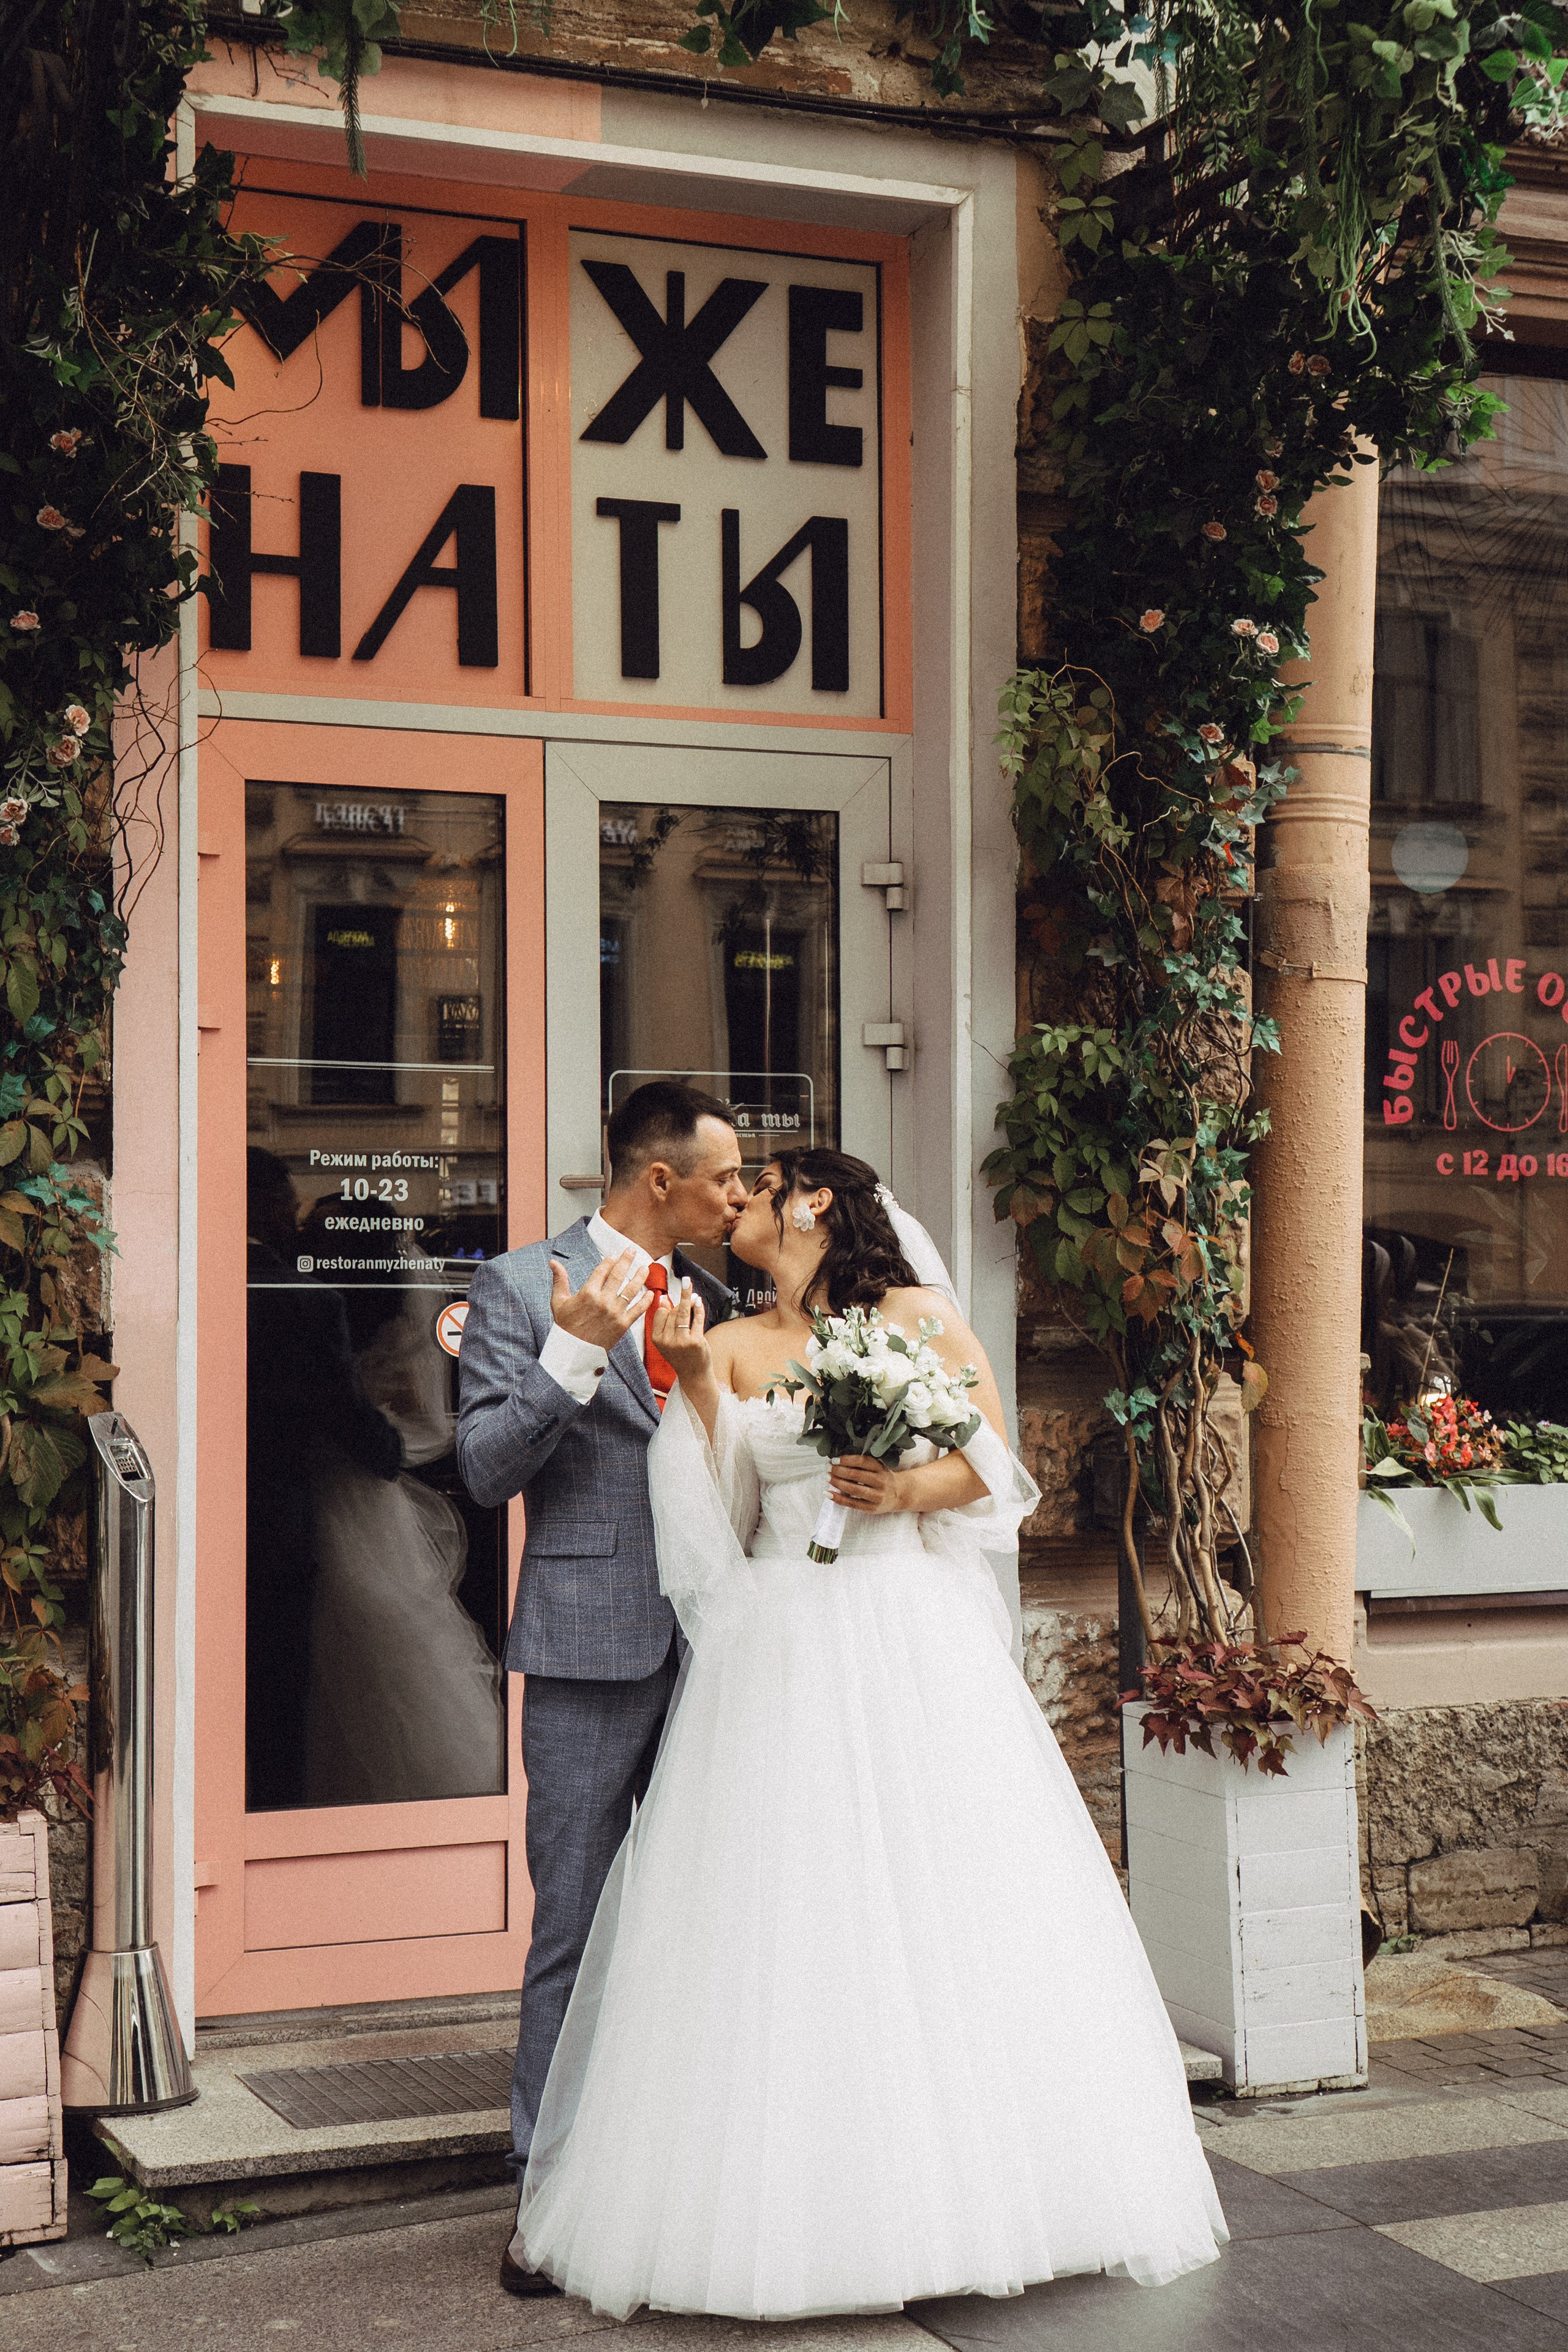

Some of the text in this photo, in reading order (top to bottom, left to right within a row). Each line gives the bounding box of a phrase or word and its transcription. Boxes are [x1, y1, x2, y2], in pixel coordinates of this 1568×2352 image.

[579, 259, 863, 466] ЖЕ
[209, 462, 849, 692] НА ТЫ
[1383, 958, 1526, 1125] БЫСТРЫЕ
[761, 1113, 801, 1128] ты
[310, 1150, 439, 1170] Режим работы:
[1463, 1150, 1489, 1175] 12
[341, 1178, 409, 1201] 10-23
[325, 1216, 424, 1232] ежедневно
[317, 1256, 445, 1273] restoranmyzhenaty
